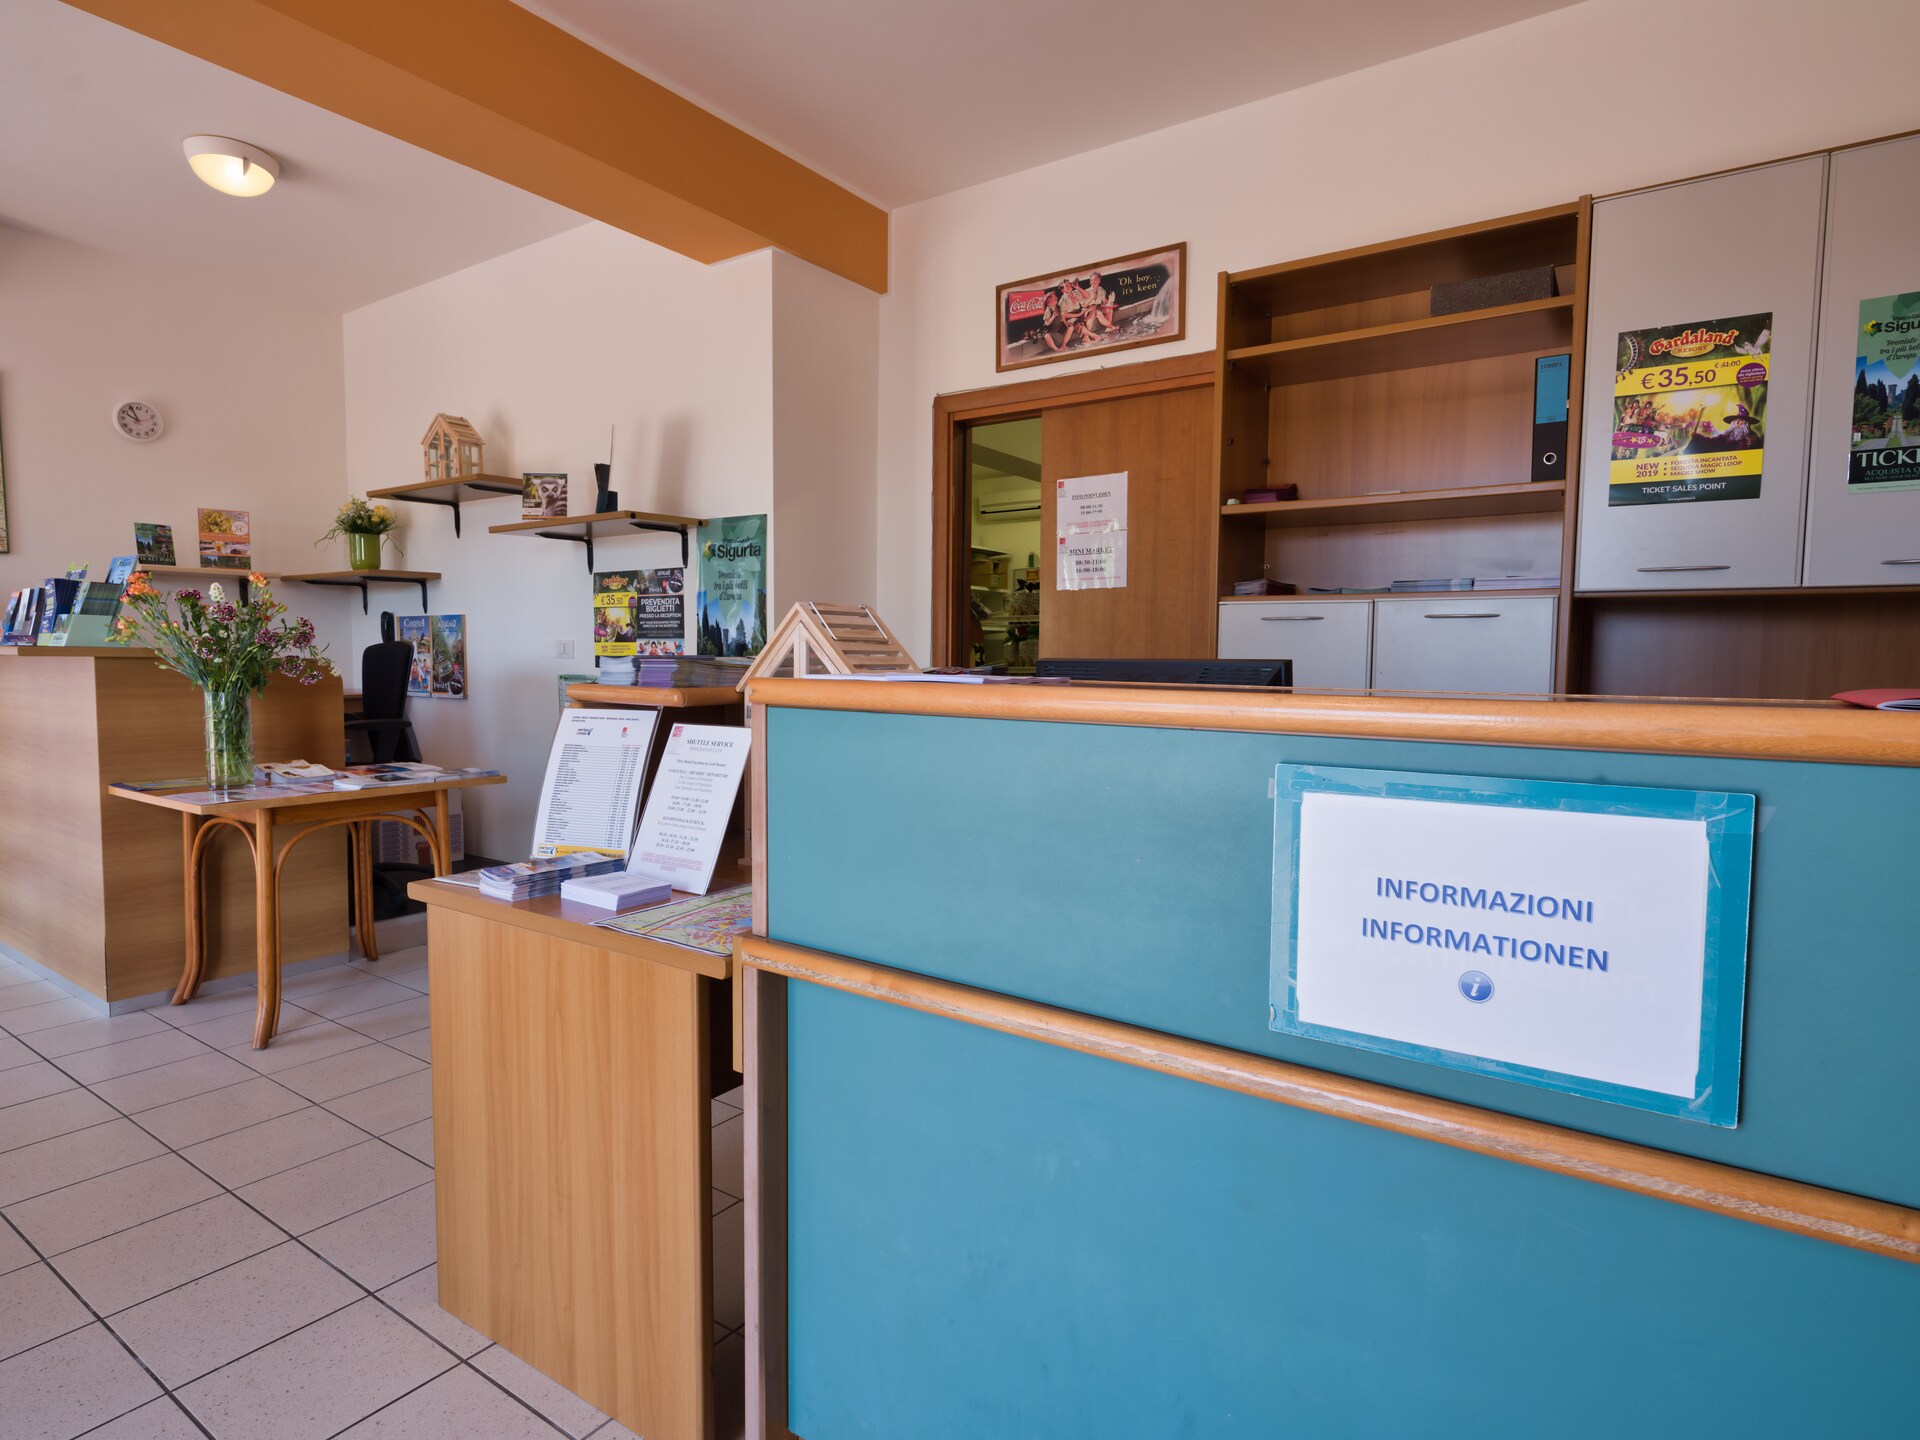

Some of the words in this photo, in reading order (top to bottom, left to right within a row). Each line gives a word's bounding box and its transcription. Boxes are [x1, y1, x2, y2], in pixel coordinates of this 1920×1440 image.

[1137, 283, 1157, 292] keen
[1649, 328, 1739, 355] Gardaland
[1677, 345, 1708, 354] RESORT
[1641, 373, 1654, 390] €
[1658, 366, 1716, 388] 35,50
[1700, 455, 1738, 463] INCANTATA
[1636, 462, 1659, 470] NEW
[1636, 469, 1658, 478] 2019
[1865, 468, 1911, 476] ACQUISTA
[1642, 485, 1670, 494] TICKET
[1672, 484, 1697, 492] SALES
[1699, 482, 1726, 490] POINT
[641, 598, 680, 606] PREVENDITA
[1376, 877, 1594, 923] INFORMAZIONI
[1362, 917, 1609, 972] INFORMATIONEN
